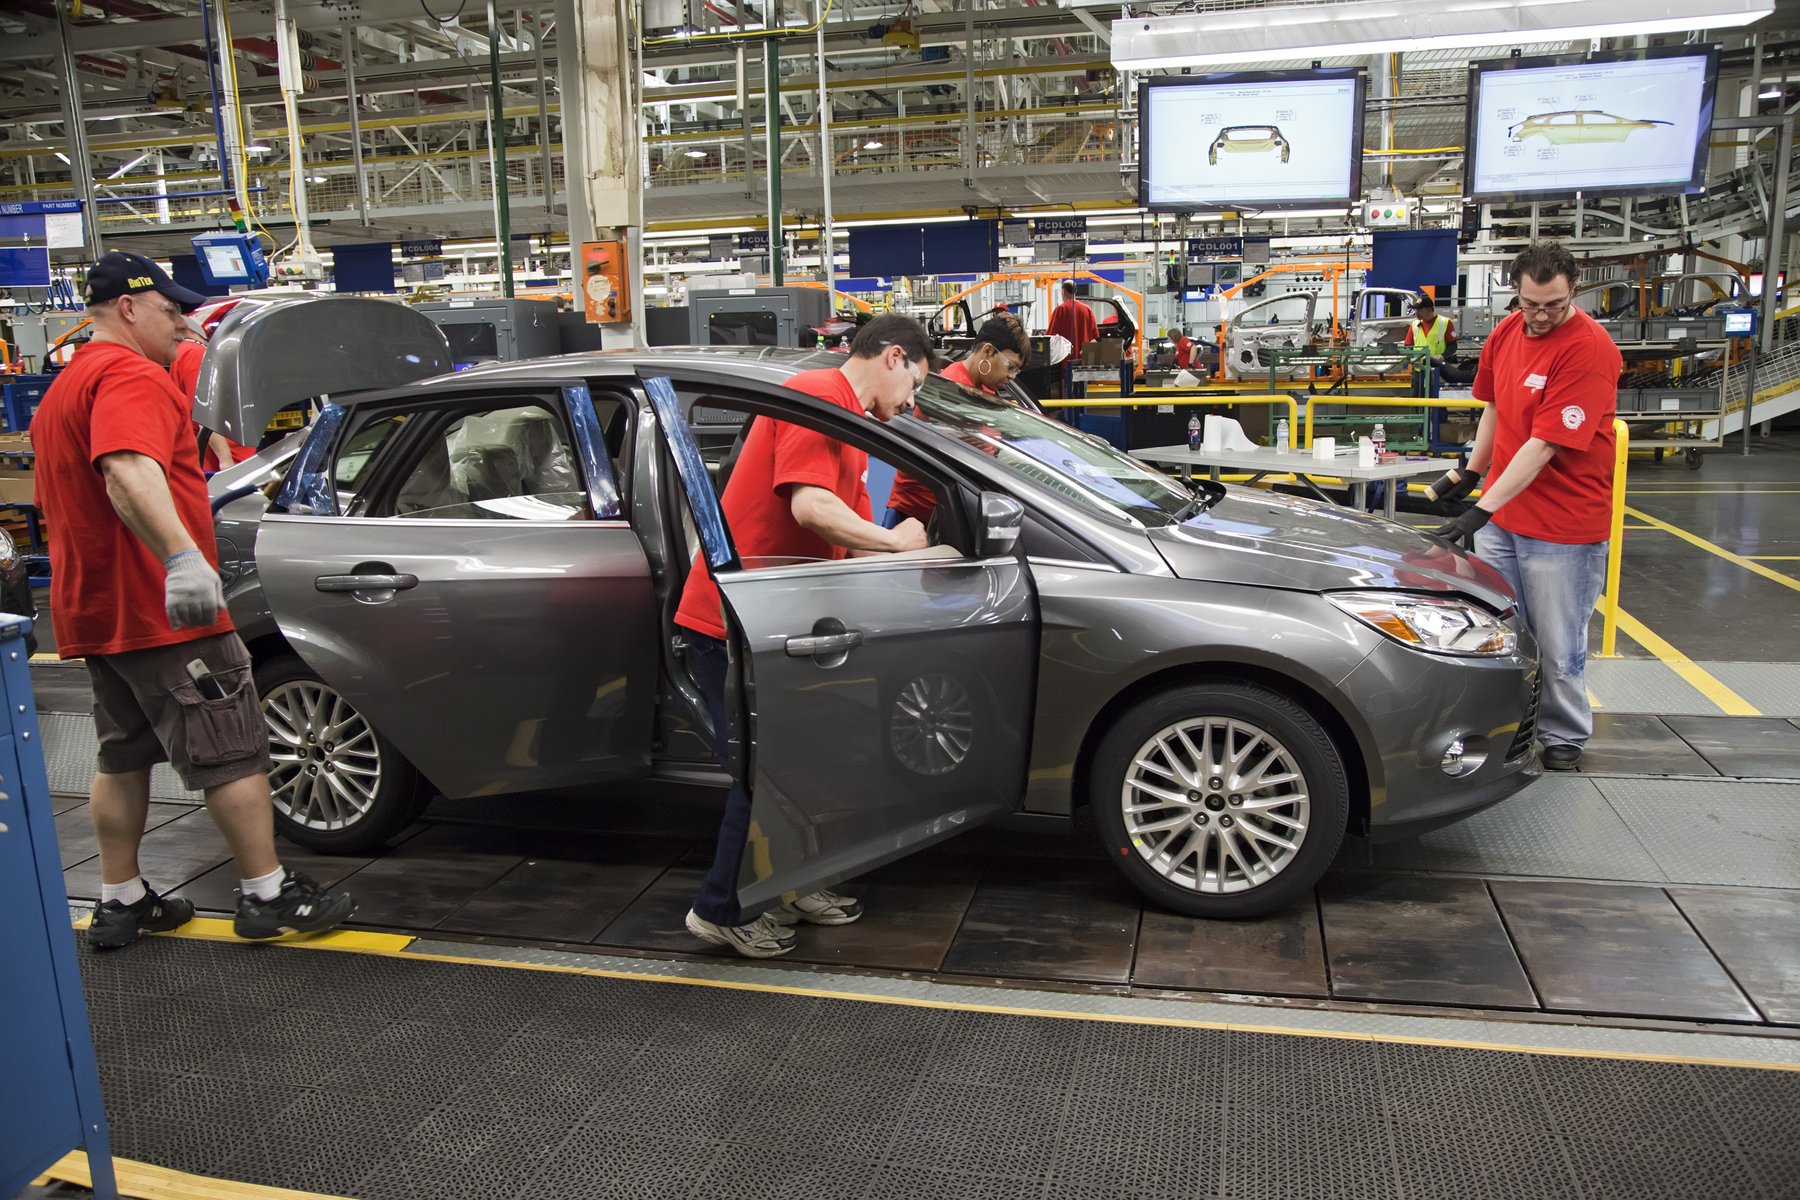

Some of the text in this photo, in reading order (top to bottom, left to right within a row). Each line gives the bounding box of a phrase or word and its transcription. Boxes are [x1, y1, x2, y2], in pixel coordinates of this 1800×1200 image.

[1, 204, 23, 214] NUMBER
[1038, 221, 1084, 229] FCDL002
[403, 244, 439, 252] FCDL004
[295, 904, 312, 916] N
